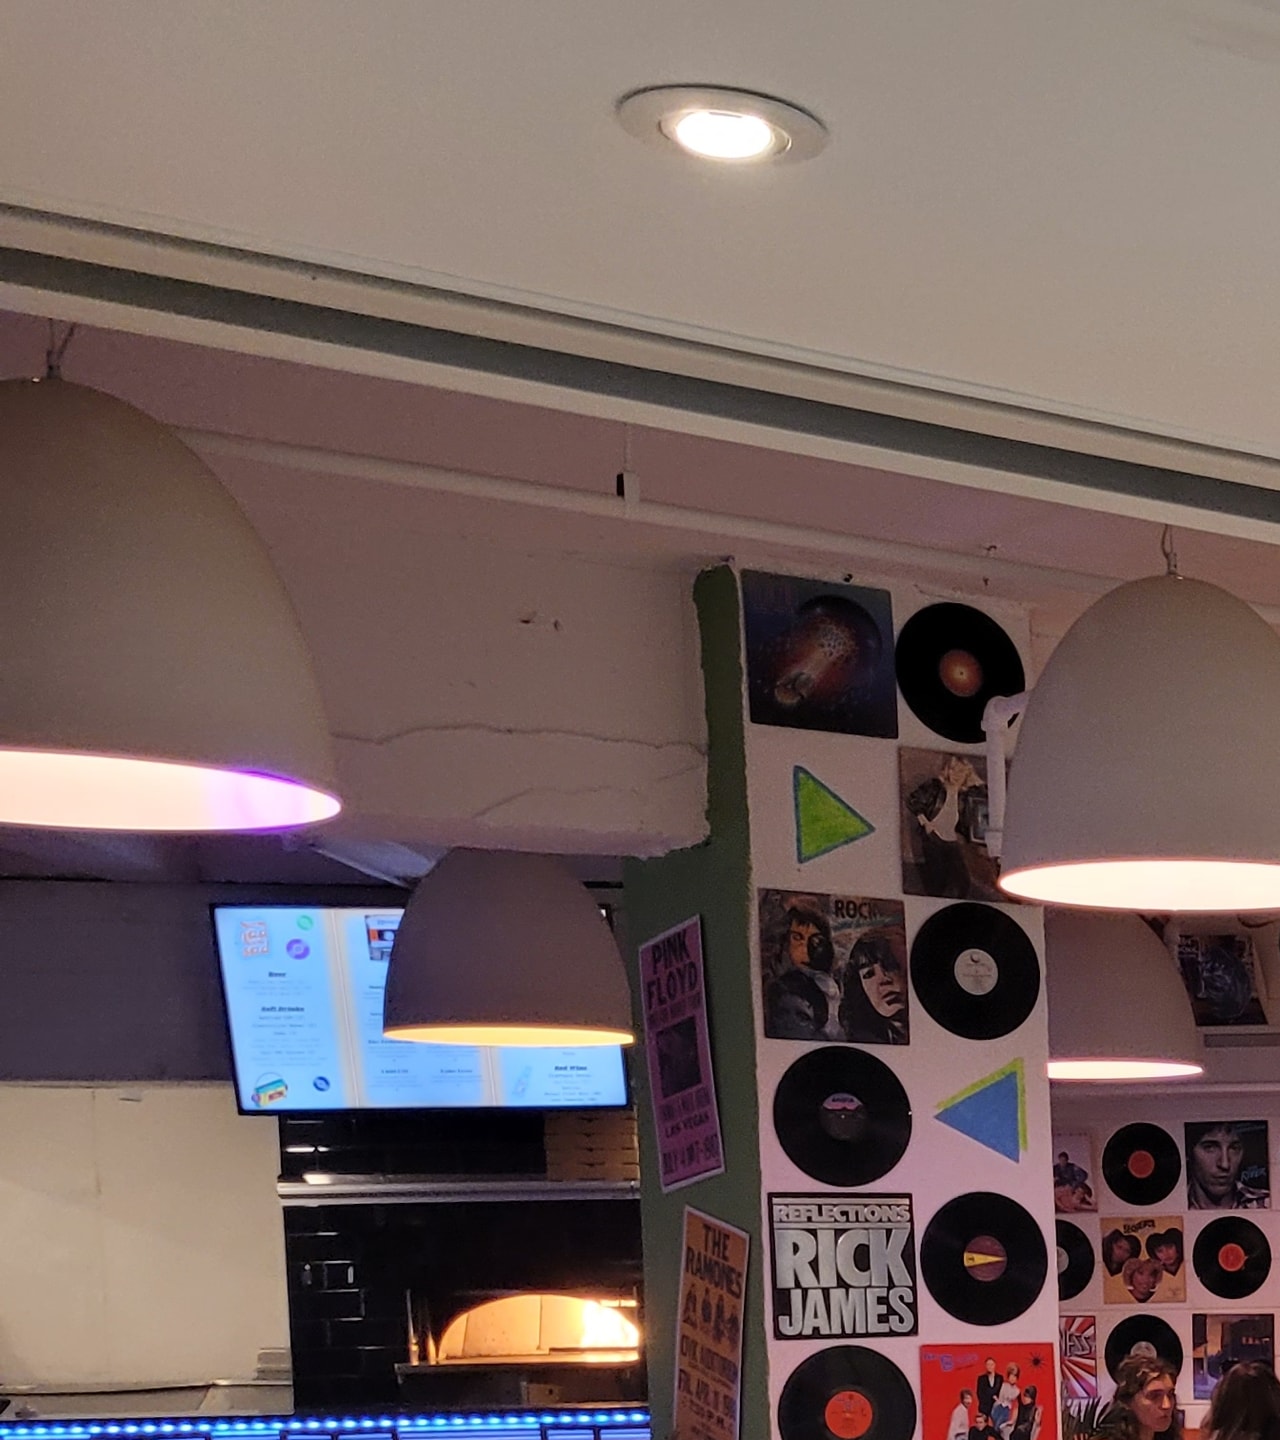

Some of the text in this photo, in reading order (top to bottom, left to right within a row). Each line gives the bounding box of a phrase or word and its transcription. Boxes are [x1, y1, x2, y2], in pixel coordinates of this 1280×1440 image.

[651, 928, 690, 976] PINK
[646, 960, 698, 1011] FLOYD
[773, 1204, 911, 1222] REFLECTIONS
[702, 1222, 731, 1263] THE
[774, 1228, 914, 1289] RICK
[778, 1286, 915, 1336] JAMES
